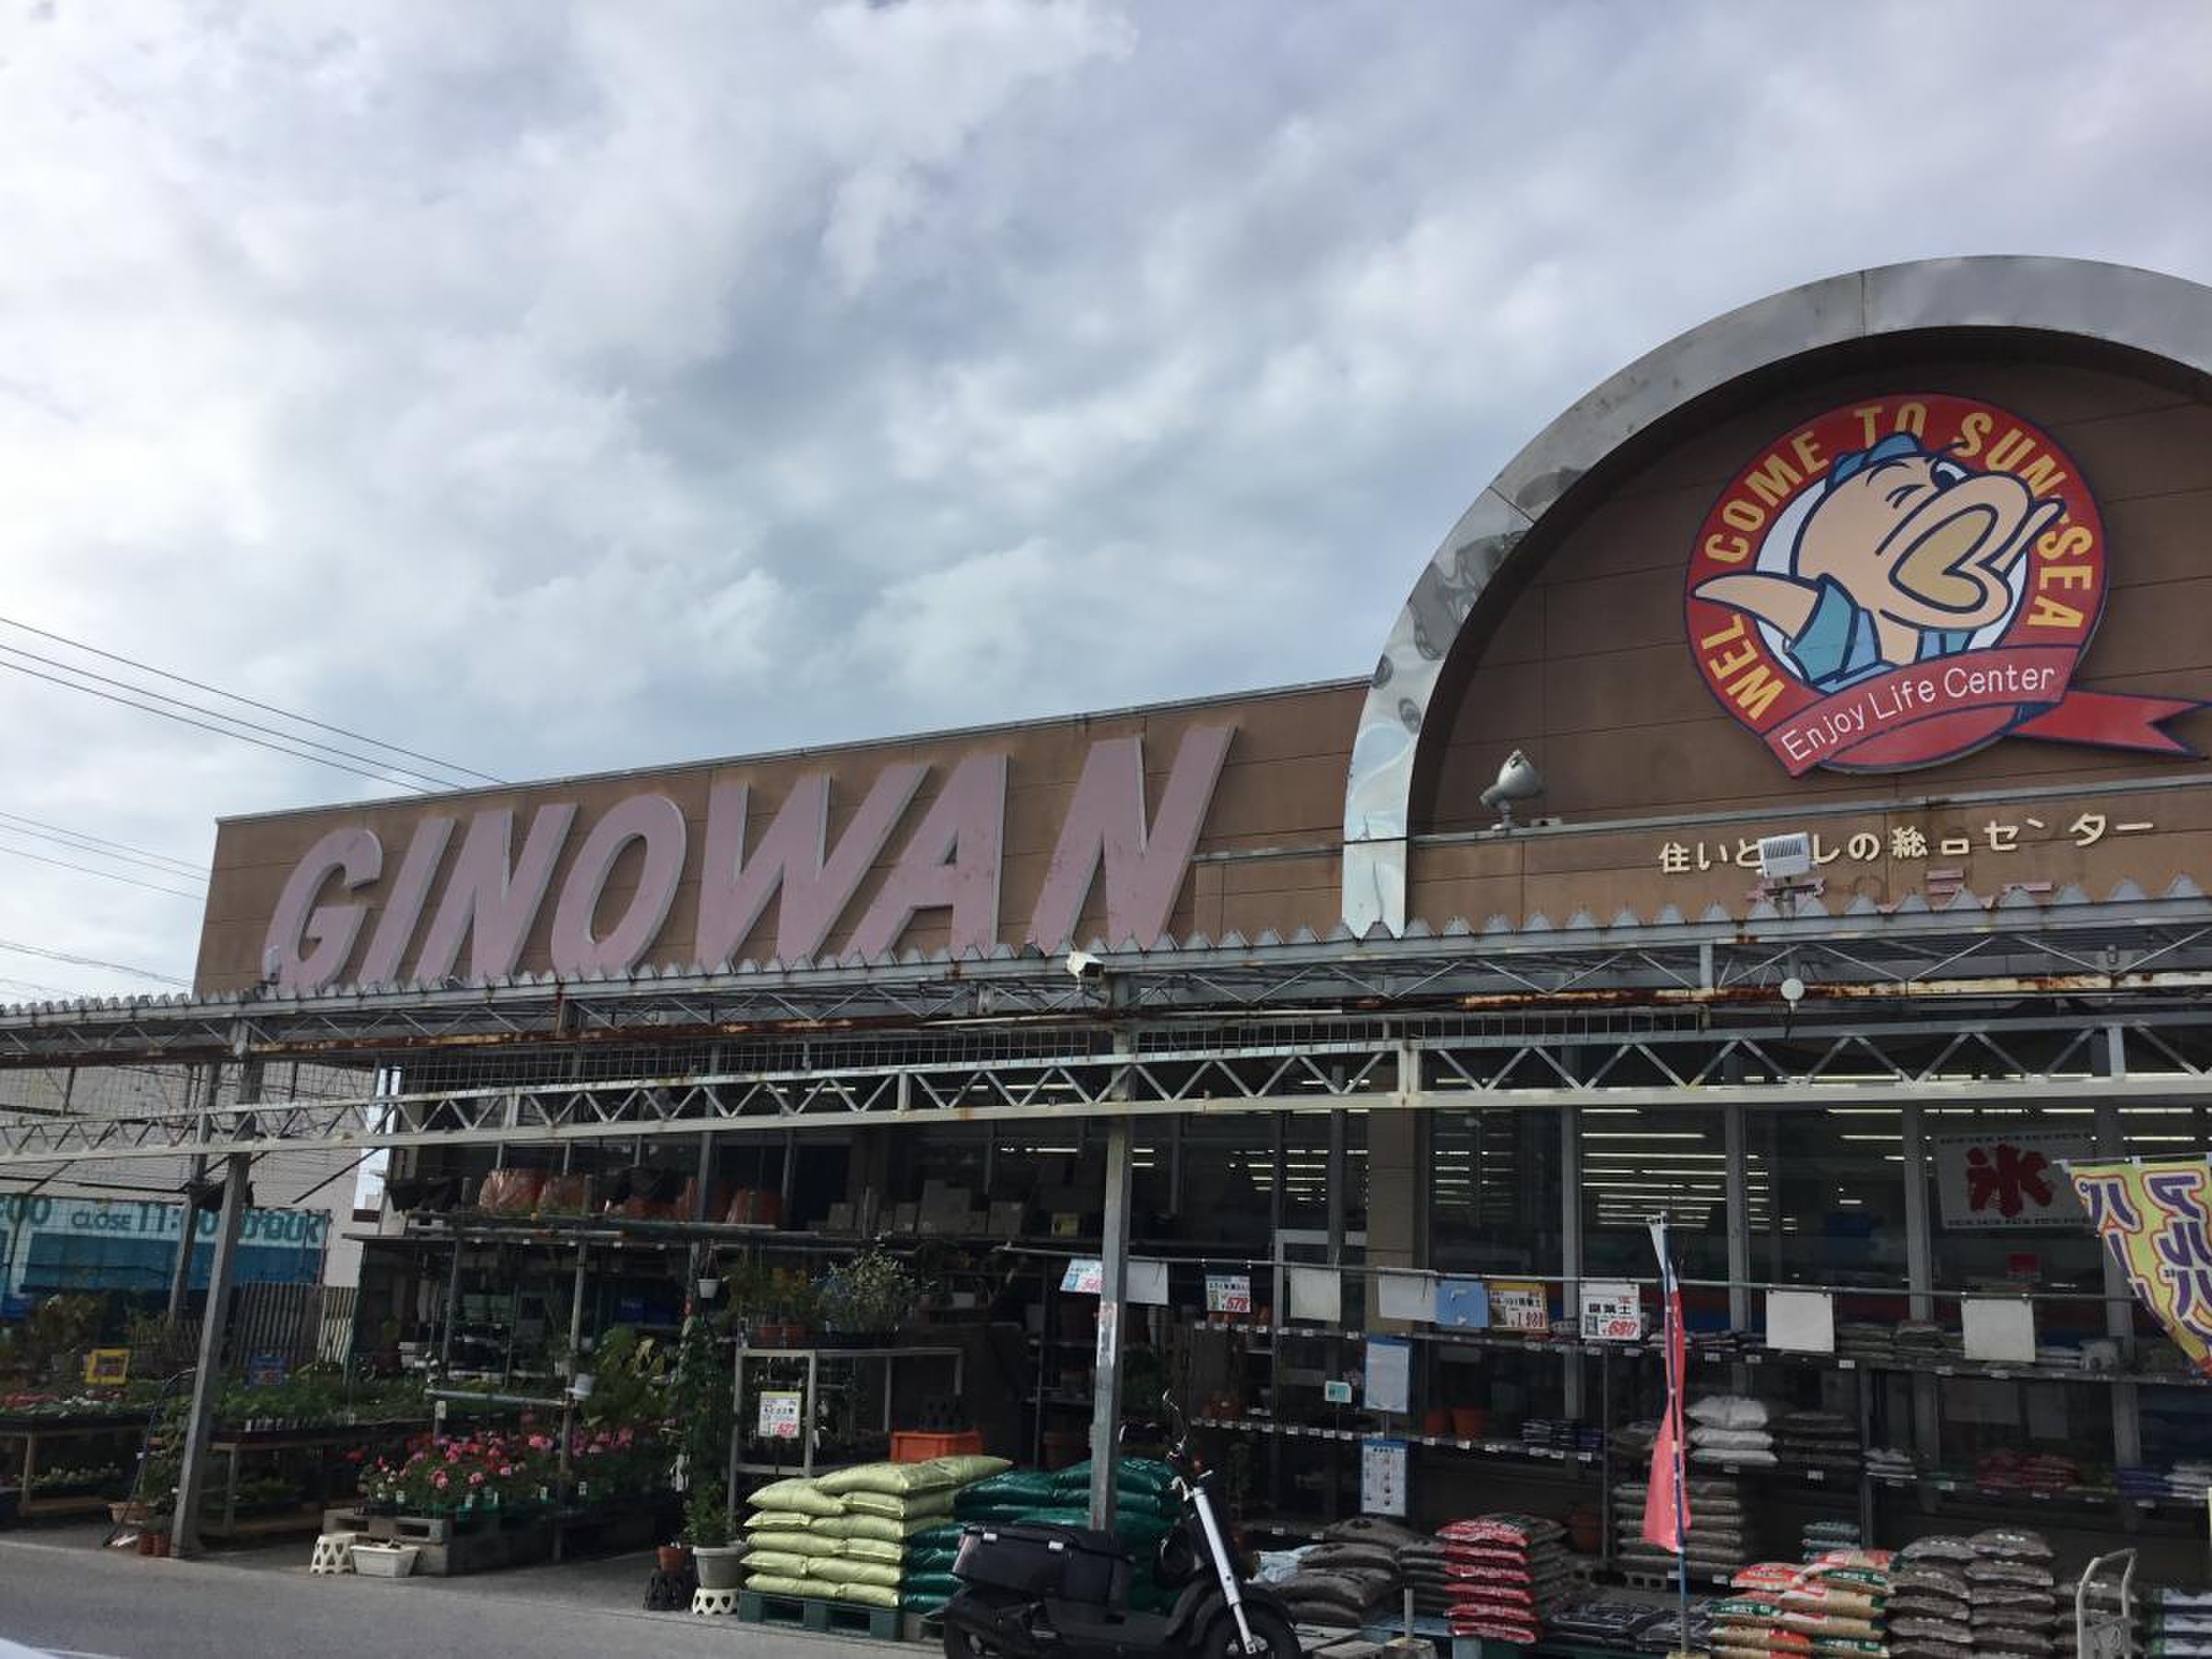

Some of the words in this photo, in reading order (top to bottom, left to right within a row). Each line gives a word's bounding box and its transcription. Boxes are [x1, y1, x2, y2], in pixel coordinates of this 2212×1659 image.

[1853, 402, 1927, 444] TO
[1705, 431, 1830, 563] COME
[2028, 525, 2093, 628] SEA
[1700, 614, 1785, 720] WEL
[1781, 703, 1865, 760] Enjoy
[1875, 679, 1936, 721] Life
[1944, 665, 2055, 697] Center
[262, 723, 1238, 994] GINOWAN
